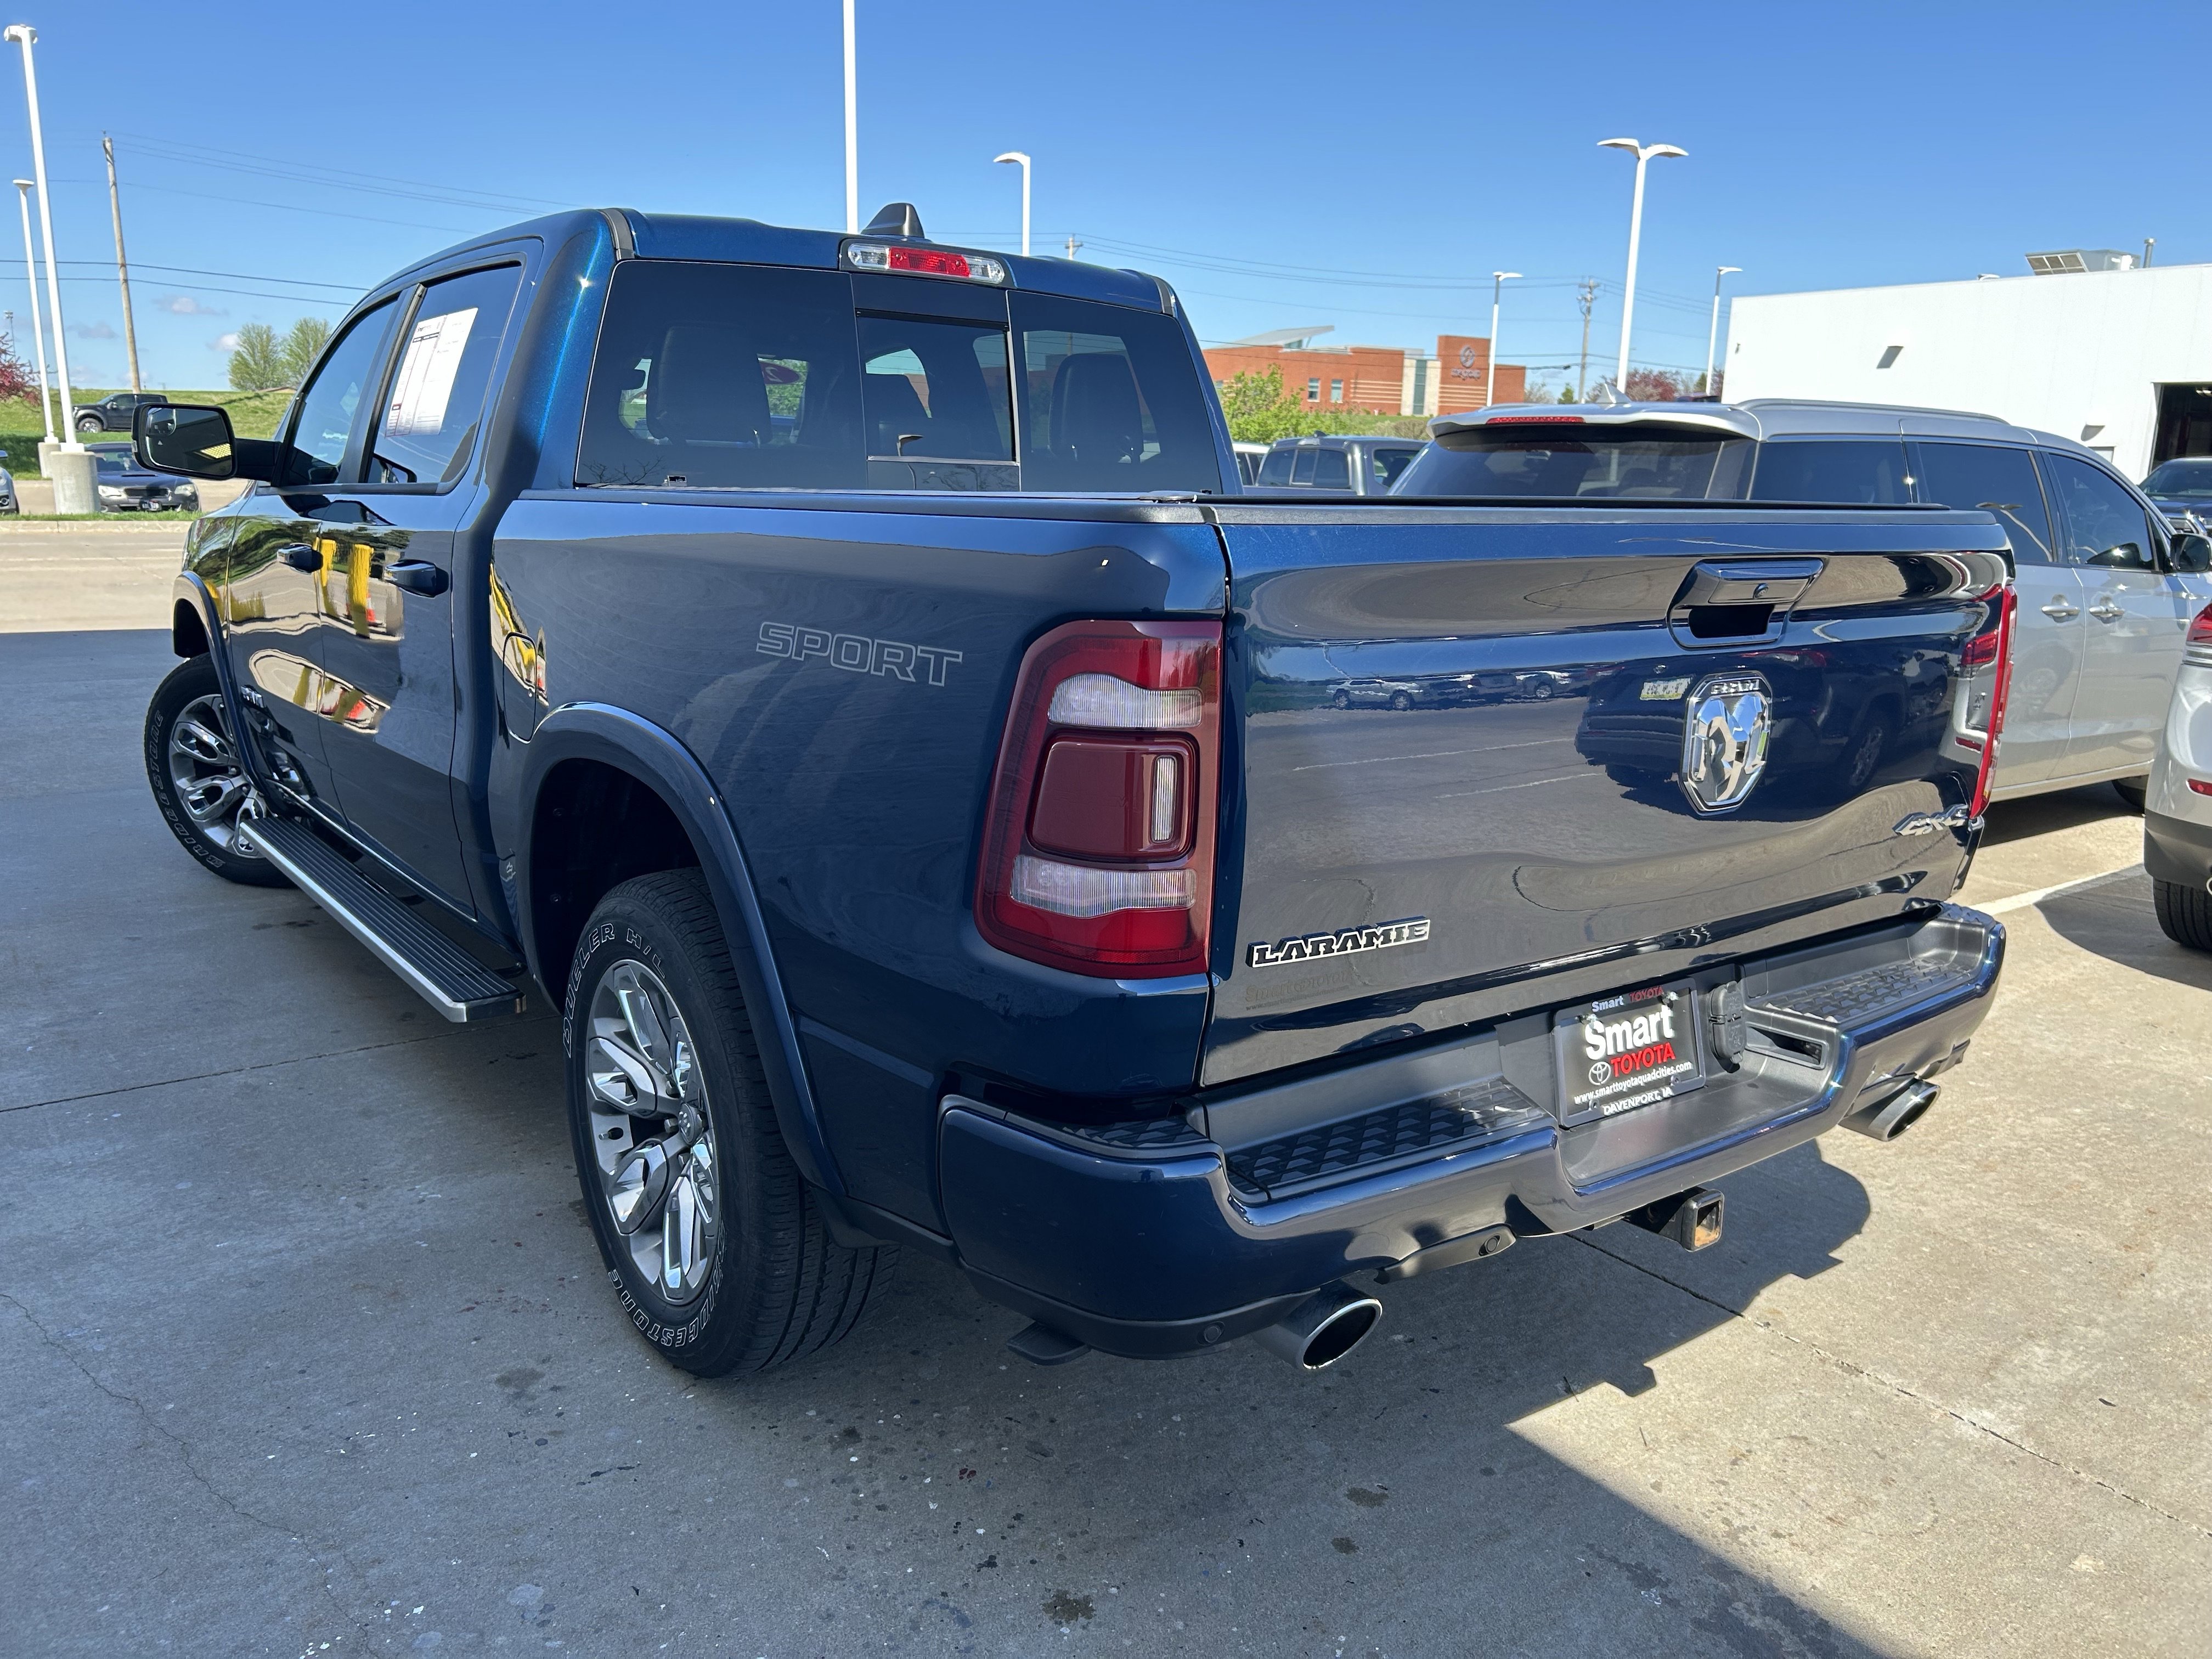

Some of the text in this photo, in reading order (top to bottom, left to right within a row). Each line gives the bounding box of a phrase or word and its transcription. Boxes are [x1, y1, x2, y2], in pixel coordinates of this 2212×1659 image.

[756, 621, 963, 687] SPORT
[149, 710, 225, 868] BRIDGESTONE
[1246, 916, 1431, 968] LARAMIE
[562, 923, 616, 1059] DUELER
[1592, 985, 1664, 1012] Smart TOYOTA
[1584, 1004, 1675, 1060] Smart
[1573, 1061, 1692, 1105] www.smarttoyotaquadcities.com
[1610, 1042, 1677, 1077] TOYOTA
[1662, 1086, 1674, 1098] IA
[608, 1211, 727, 1347] BRIDGESTONE
